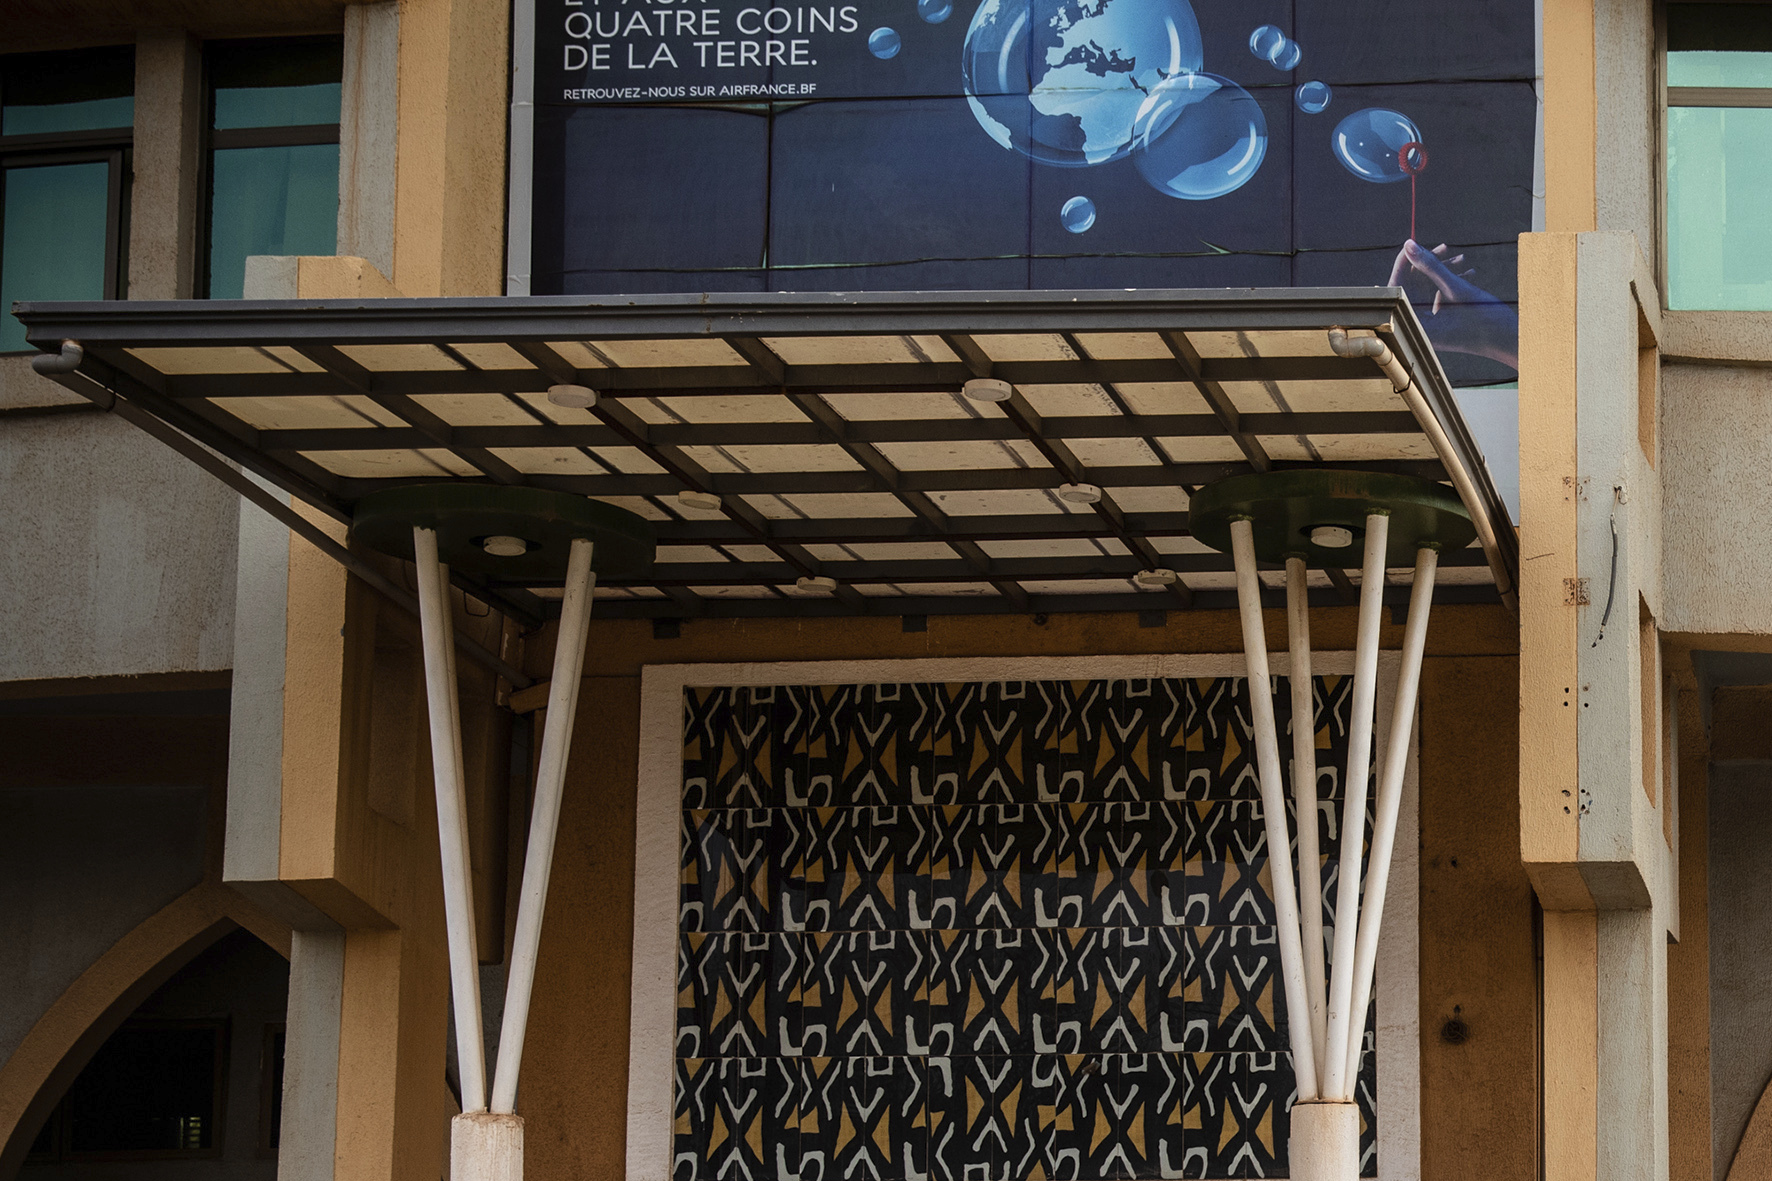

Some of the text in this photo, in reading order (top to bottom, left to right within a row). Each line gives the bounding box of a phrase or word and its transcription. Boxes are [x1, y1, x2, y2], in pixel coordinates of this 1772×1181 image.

[564, 6, 859, 40] QUATRE COINS
[563, 39, 818, 71] DE LA TERRE.
[563, 83, 817, 100] RETROUVEZ-NOUS SUR AIRFRANCE.BF
